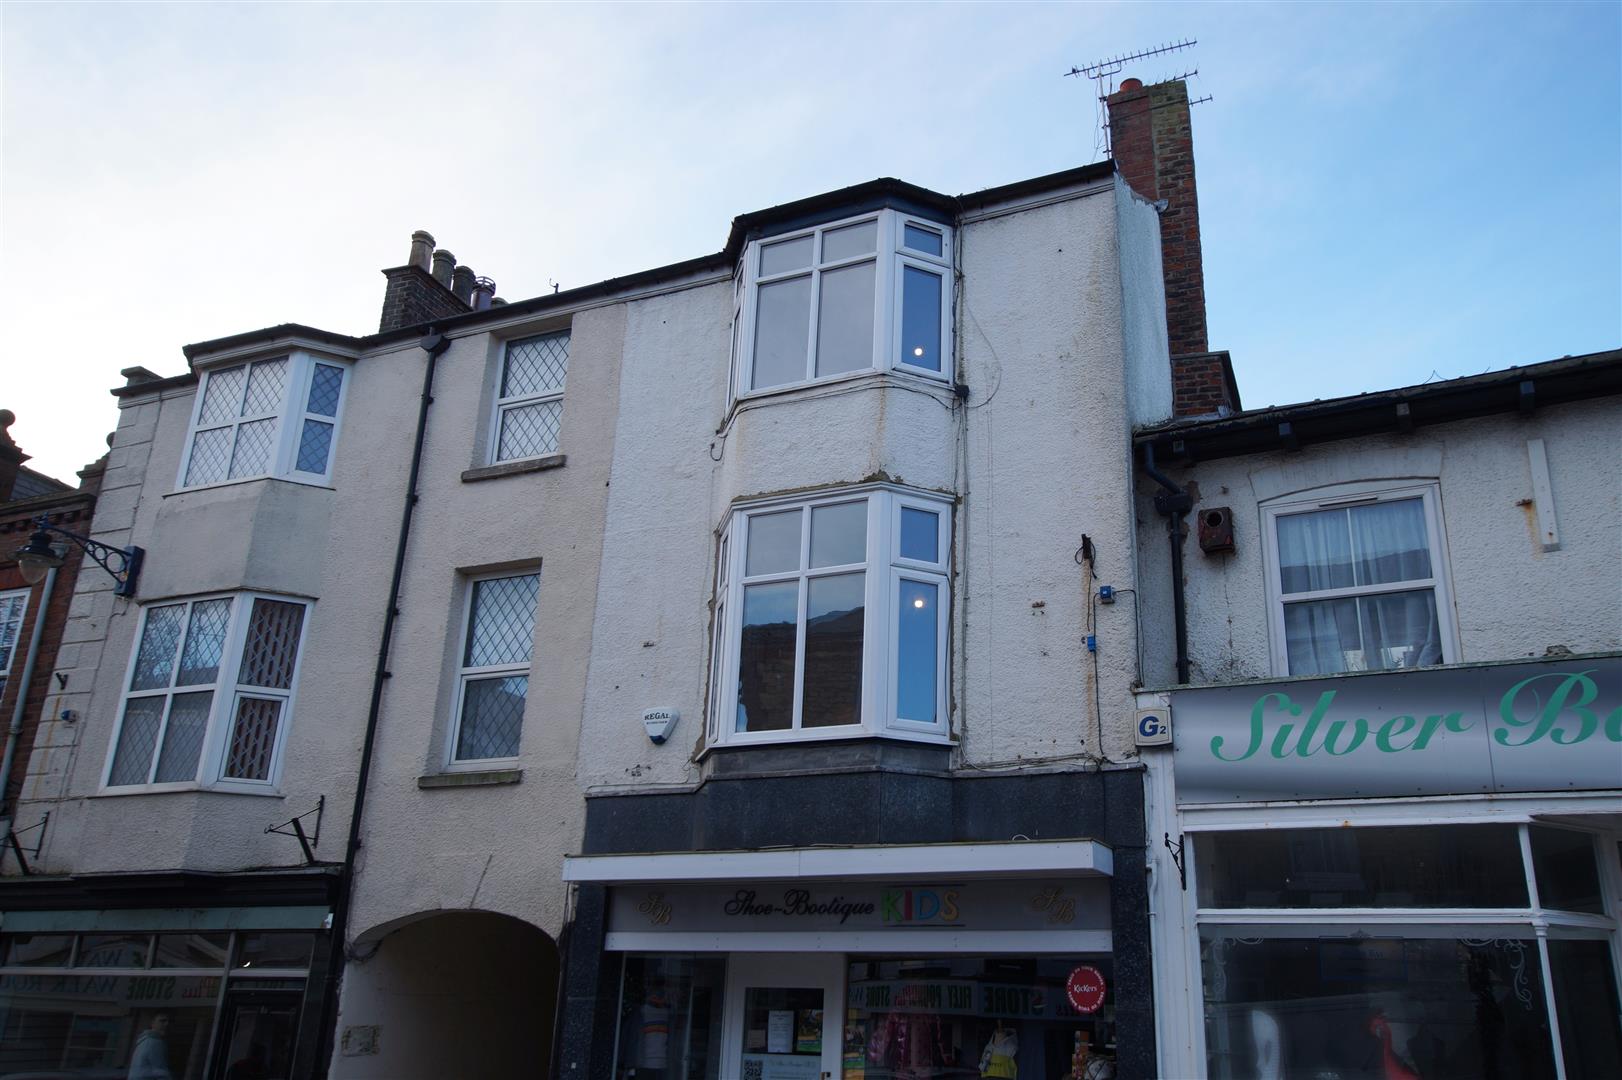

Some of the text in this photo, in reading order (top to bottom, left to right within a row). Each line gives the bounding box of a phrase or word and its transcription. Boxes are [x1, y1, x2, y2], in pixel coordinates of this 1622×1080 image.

[644, 711, 671, 721] REGAL
[1210, 689, 1475, 762] Silver
[724, 888, 961, 924] Shoe-Bootique KIDS
